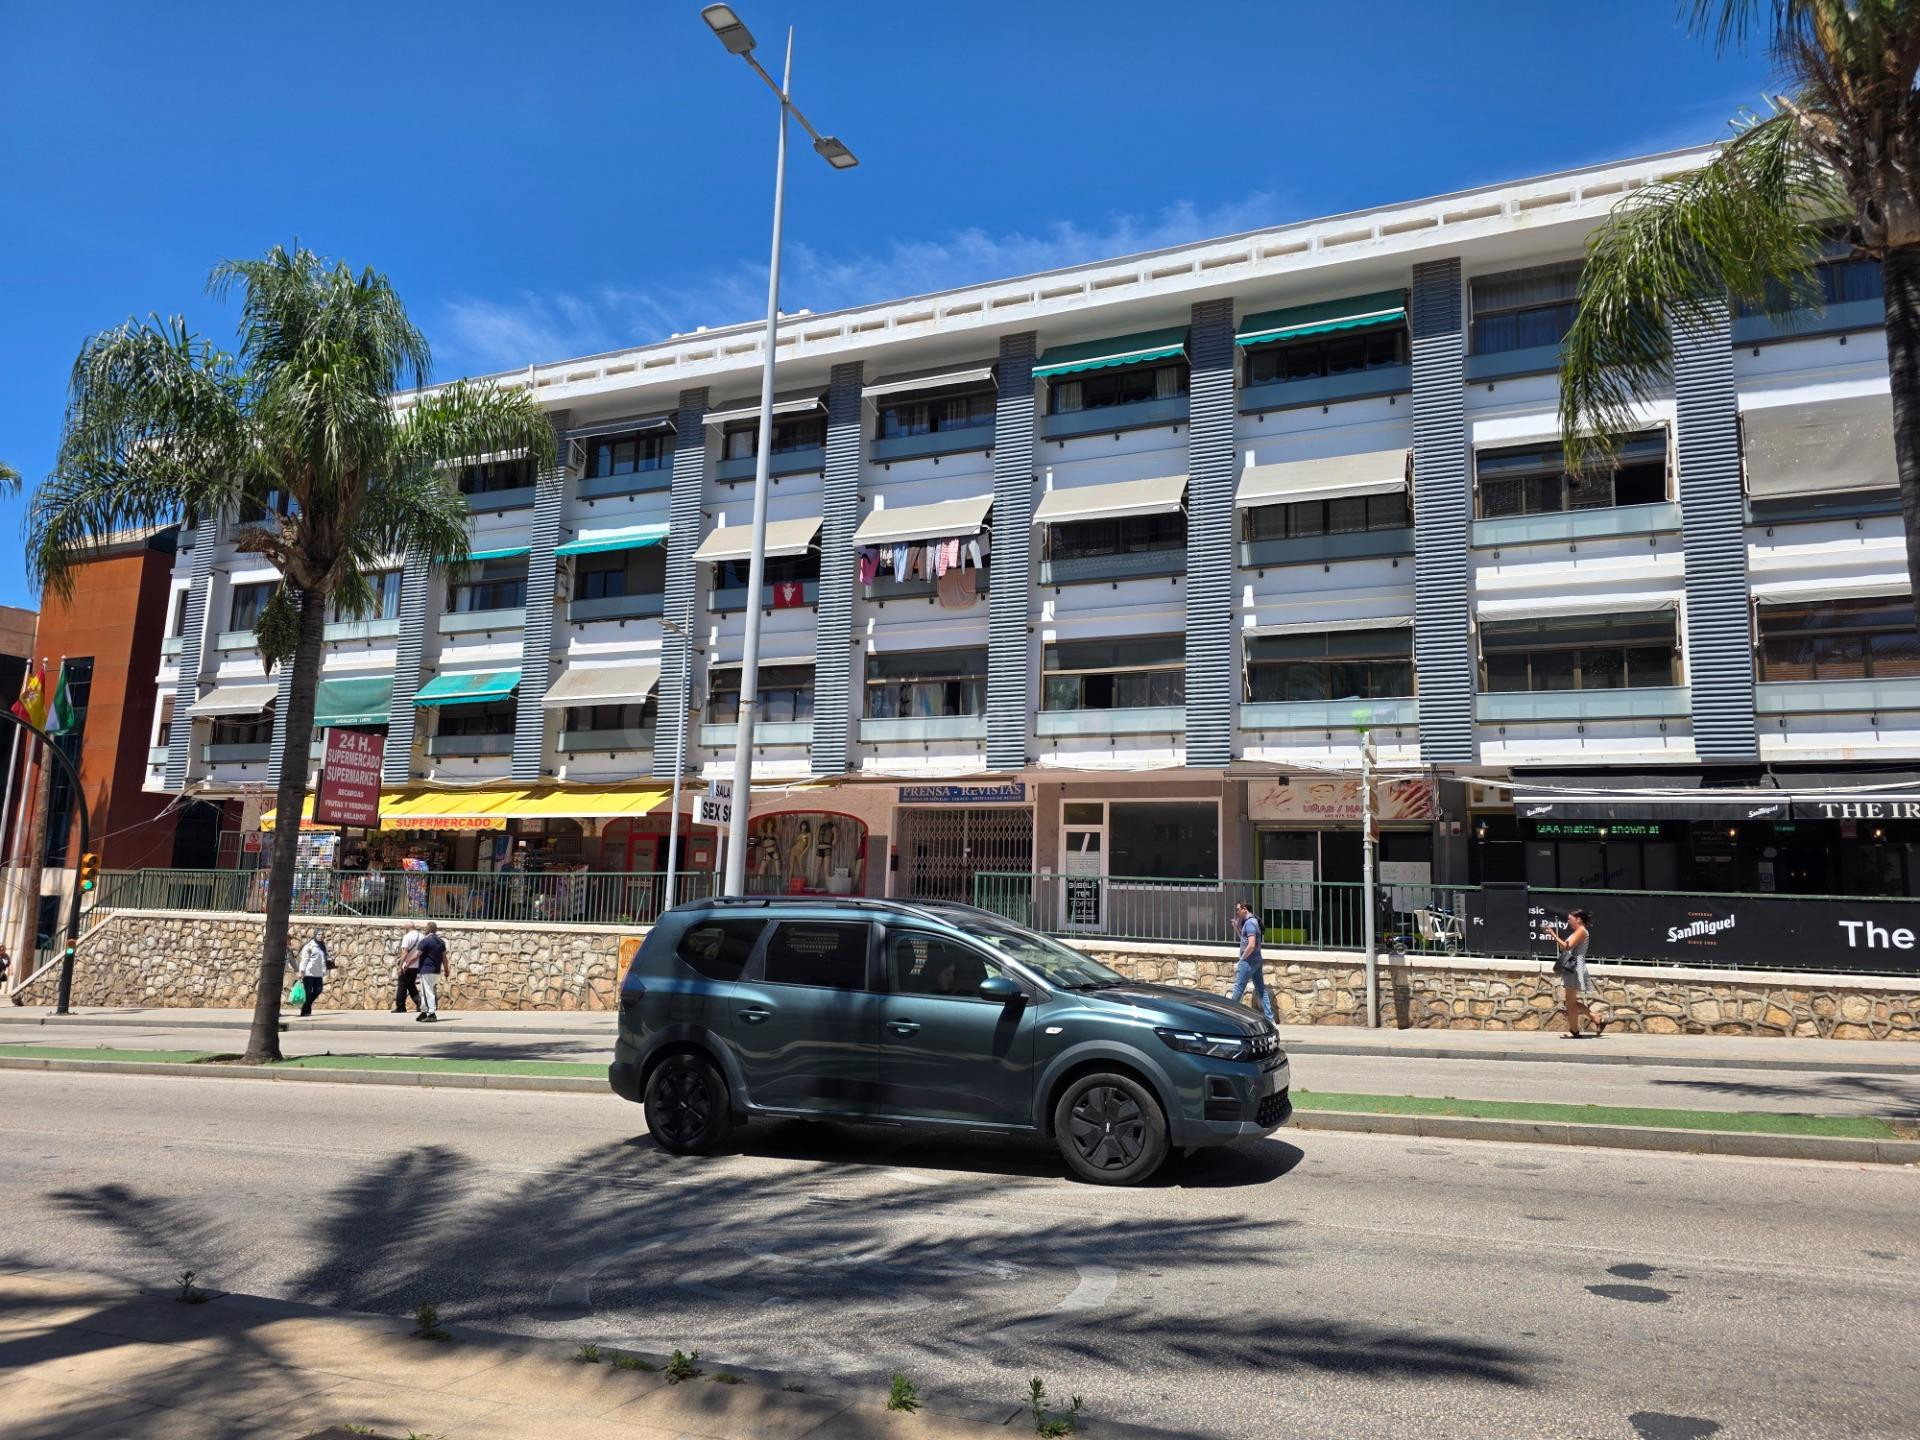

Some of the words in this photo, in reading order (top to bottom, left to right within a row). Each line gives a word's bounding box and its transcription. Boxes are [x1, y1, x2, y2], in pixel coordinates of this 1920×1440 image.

[339, 733, 355, 750] 24
[358, 737, 372, 753] H.
[327, 748, 380, 769] SUPERMERCADO
[326, 766, 379, 787] SUPERMARKET
[715, 784, 731, 799] SALA
[903, 786, 951, 797] PRENSA
[961, 784, 1022, 796] REVISTAS
[702, 801, 721, 821] SEX
[1302, 803, 1335, 813] UÑAS
[1819, 802, 1884, 819] THE
[396, 818, 491, 828] SUPERMERCADO
[1838, 920, 1916, 949] The
